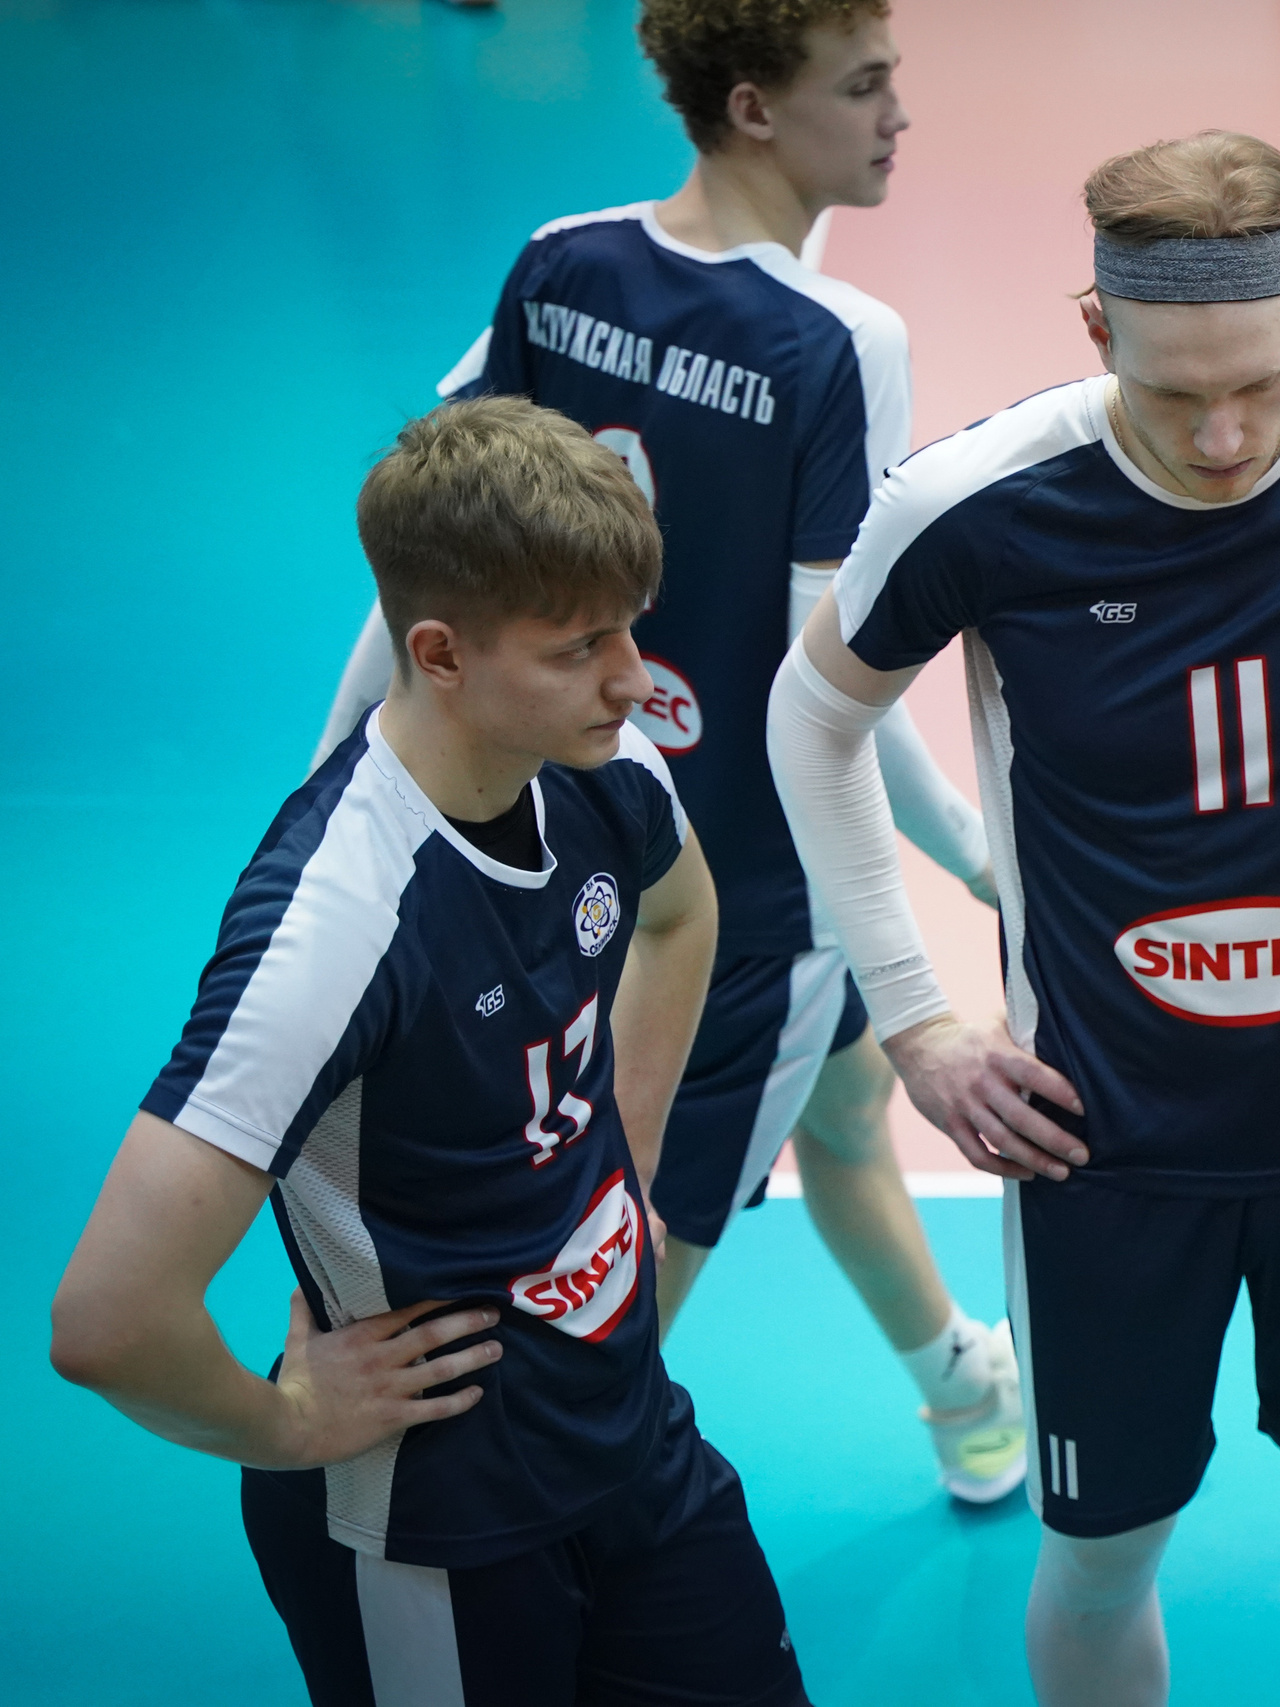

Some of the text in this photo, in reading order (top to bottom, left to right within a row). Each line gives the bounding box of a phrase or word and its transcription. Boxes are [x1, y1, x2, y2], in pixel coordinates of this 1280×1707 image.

[523, 300, 776, 426] КЛУЖСКАЯ ОБЛАСТЬ
[1187, 655, 1274, 815] 11
[524, 990, 598, 1170] 17
[523, 1204, 634, 1321] SINTE
[1048, 1433, 1080, 1501] 11
